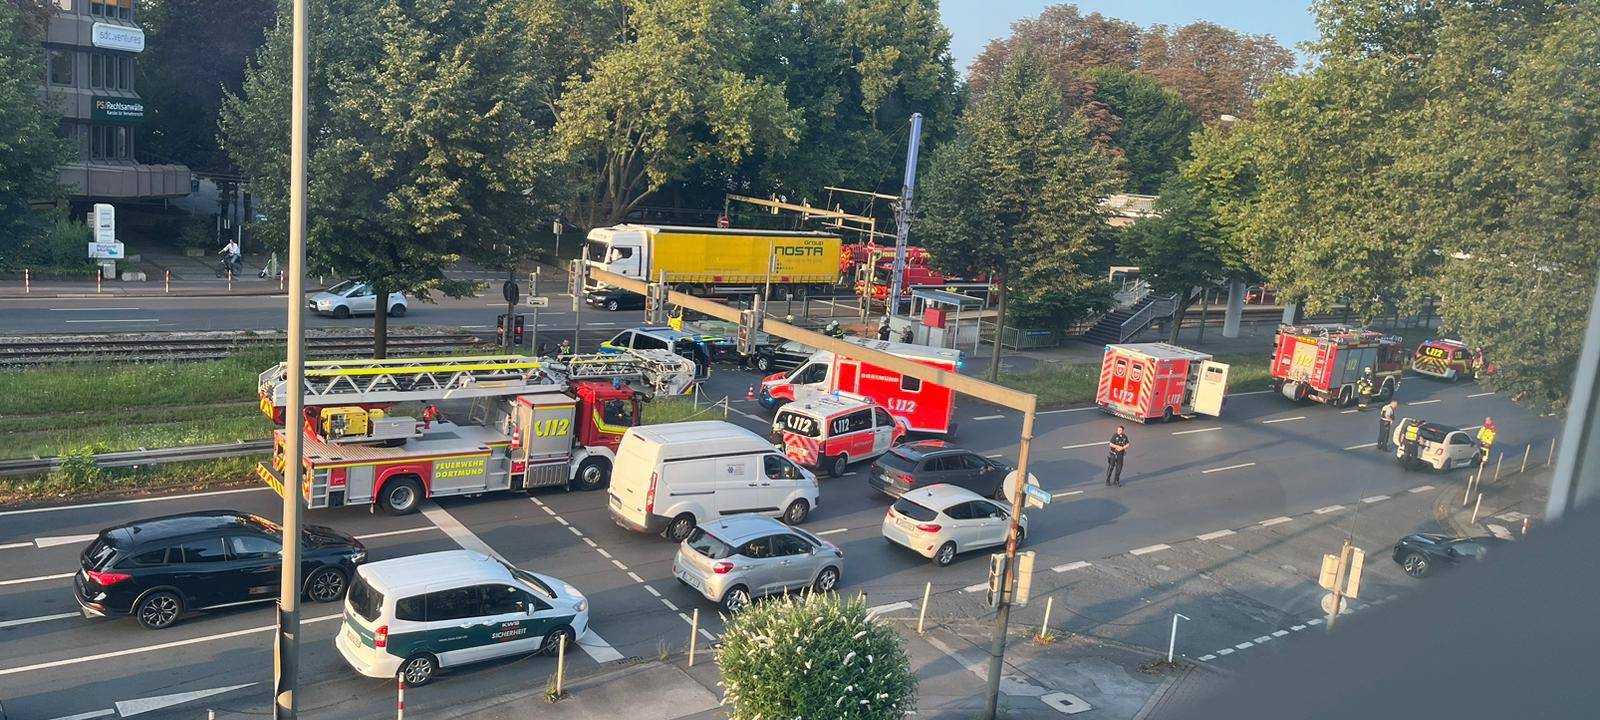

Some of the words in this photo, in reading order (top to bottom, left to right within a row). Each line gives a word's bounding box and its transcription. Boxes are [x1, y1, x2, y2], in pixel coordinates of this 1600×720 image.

[861, 373, 899, 382] DORTMUND
[1119, 390, 1134, 402] 112
[895, 399, 917, 412] 112
[543, 418, 570, 436] 112
[793, 416, 812, 432] 112
[838, 419, 850, 432] 112
[435, 460, 485, 470] FEUERWEHR
[435, 468, 484, 478] DORTMUND
[492, 628, 527, 639] SICHERHEIT
